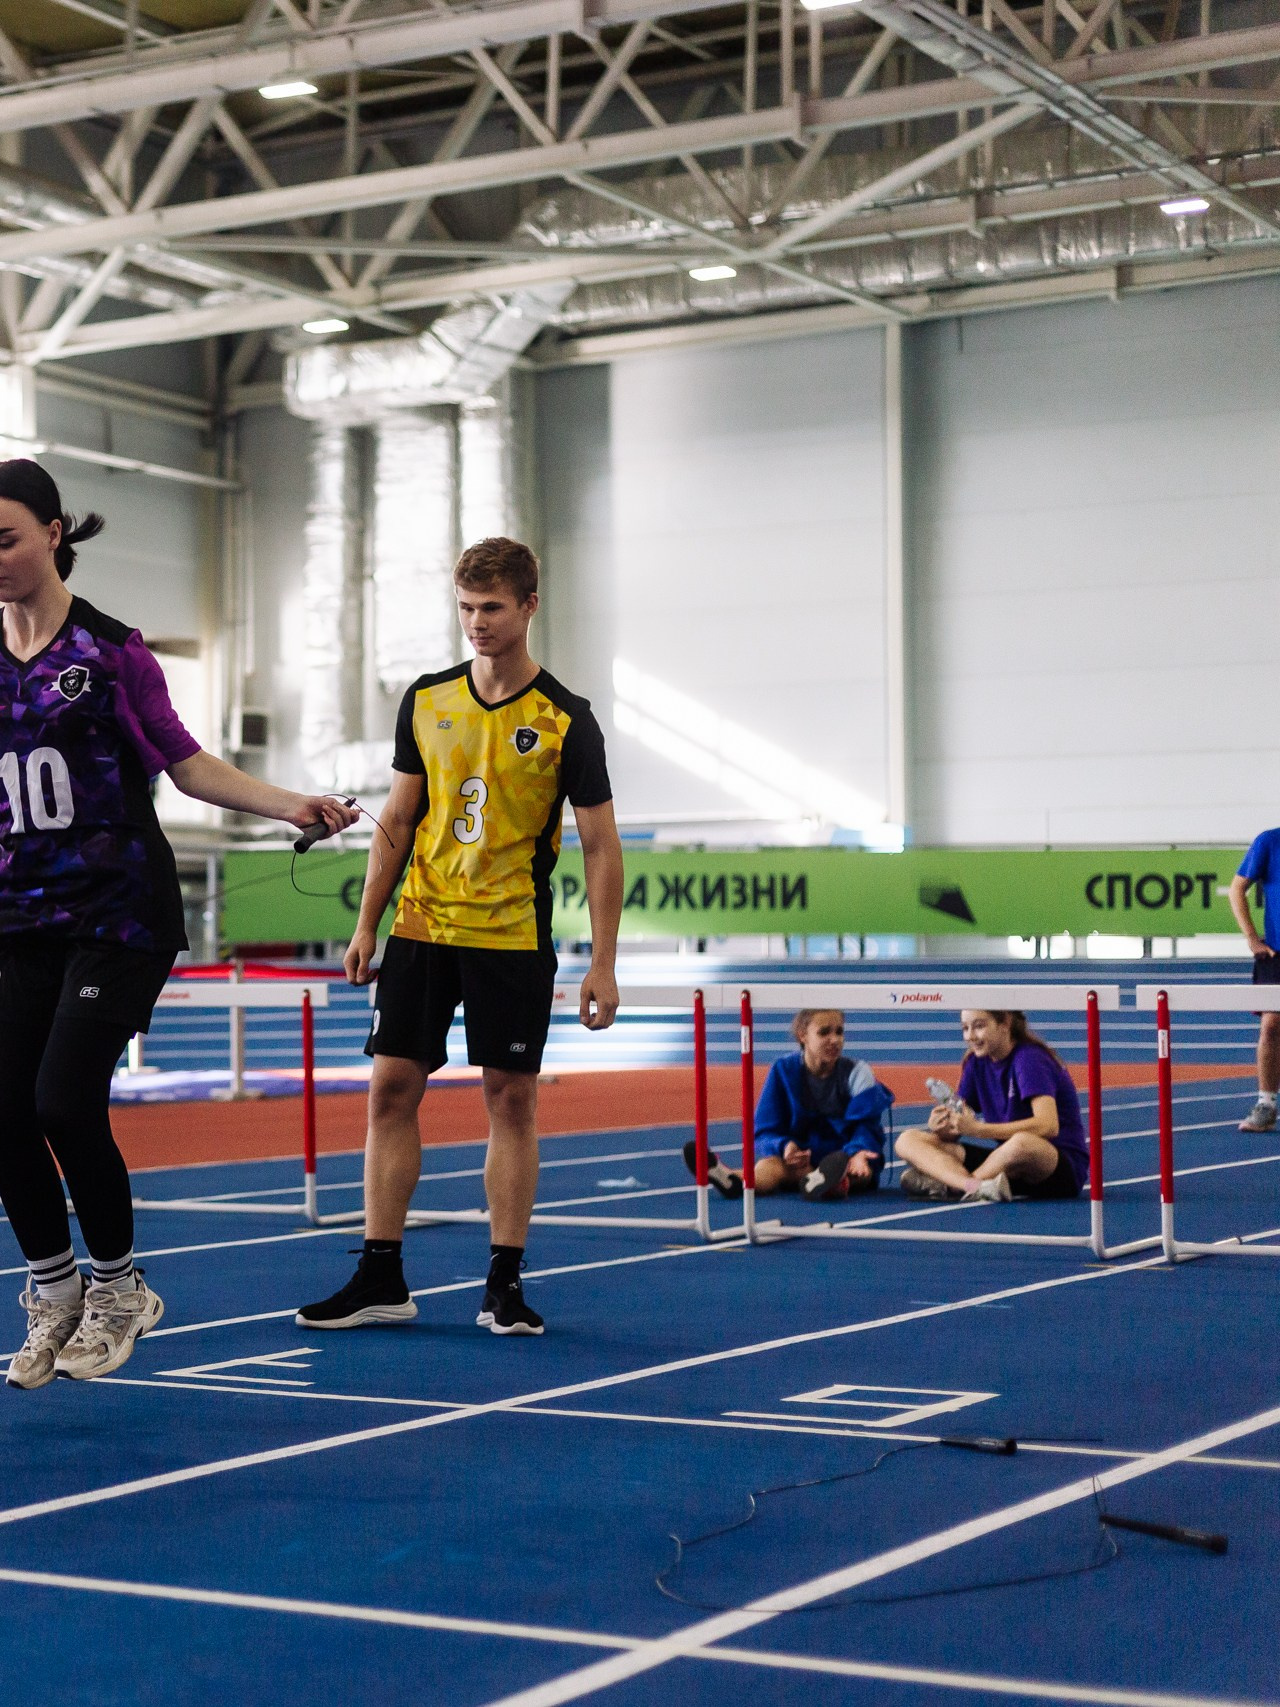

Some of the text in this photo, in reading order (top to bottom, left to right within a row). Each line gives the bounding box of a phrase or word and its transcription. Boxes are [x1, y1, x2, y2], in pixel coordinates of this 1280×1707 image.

[452, 776, 489, 845] 3
[658, 873, 809, 911] ЖИЗНИ
[1085, 872, 1218, 910] СПОРТ
[79, 986, 100, 998] GS
[901, 992, 943, 1004] polanik
[510, 1042, 526, 1053] GS
